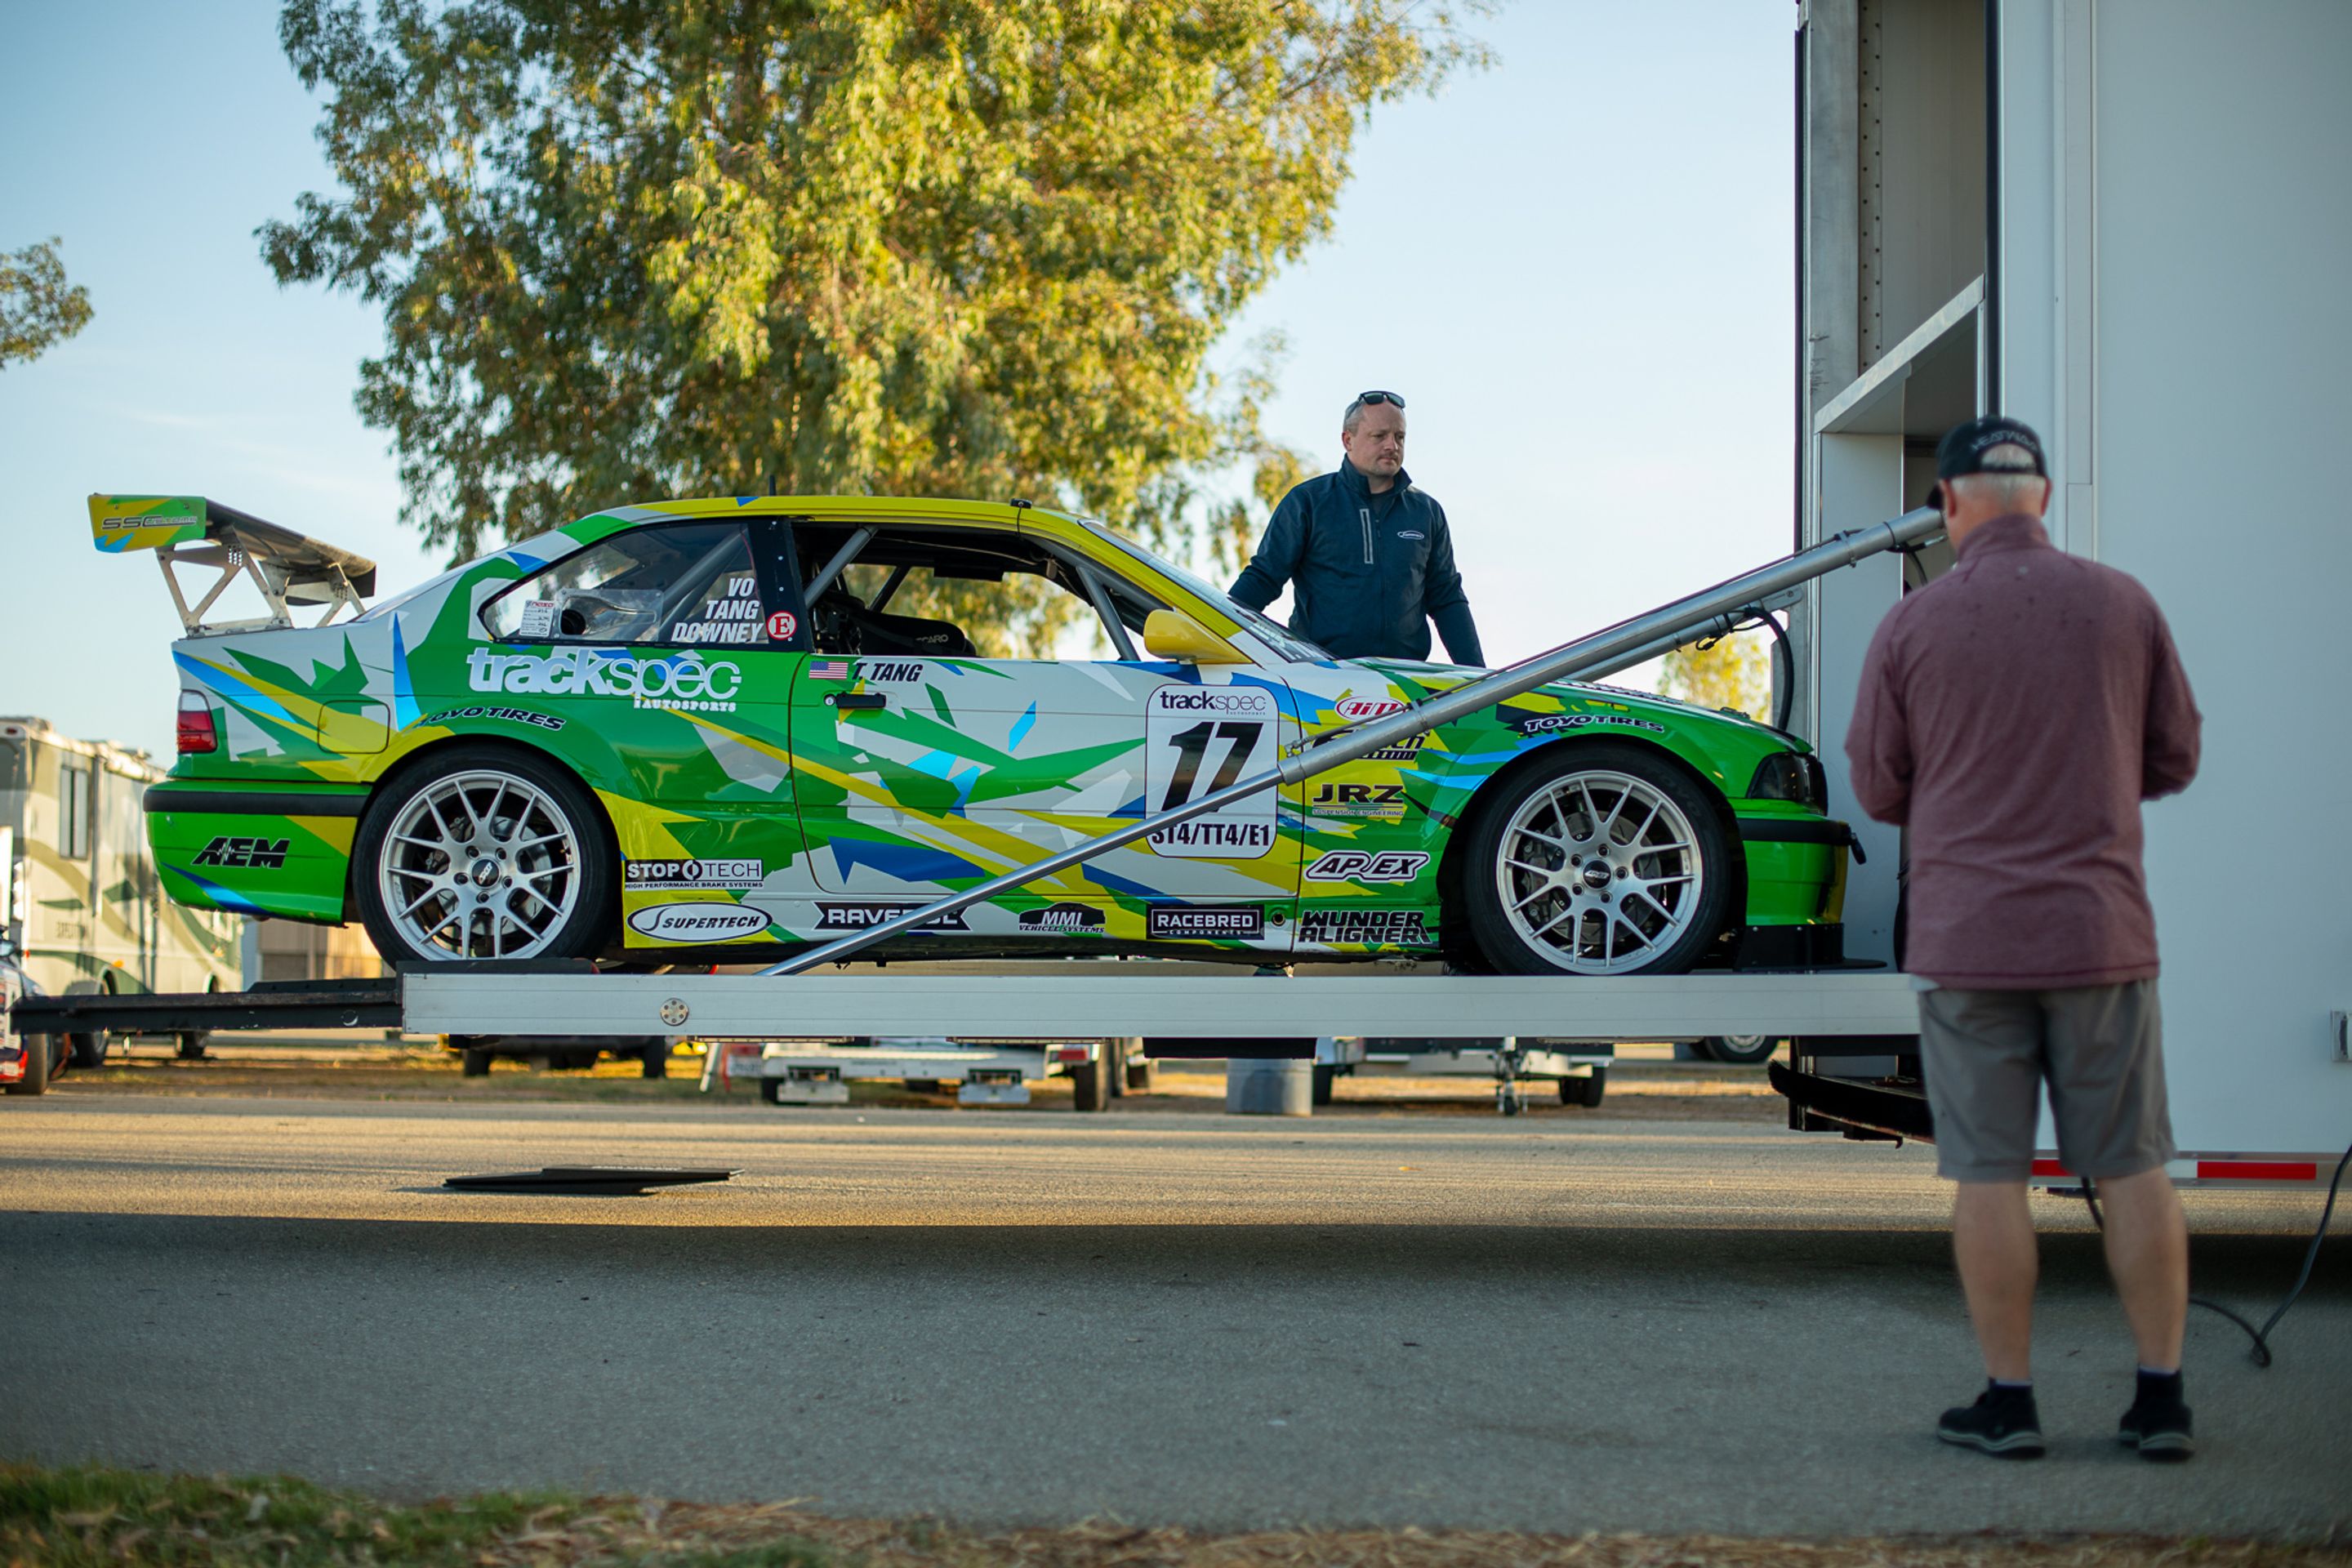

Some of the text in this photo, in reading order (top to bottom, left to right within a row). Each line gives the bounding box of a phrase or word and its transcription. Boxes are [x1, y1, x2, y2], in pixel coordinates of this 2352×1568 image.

[727, 577, 755, 597] VO
[705, 600, 760, 620] TANG
[670, 622, 764, 643] DOWNEY
[467, 647, 742, 708] trackspec
[851, 662, 924, 682] T. TANG
[642, 698, 737, 712] AUTOSPORTS
[1160, 690, 1266, 715] trackspec
[487, 706, 567, 731] TIRES
[1525, 715, 1665, 733] TOYO TIRES
[1161, 721, 1263, 813] 17
[1312, 783, 1404, 804] JRZ
[1152, 822, 1269, 846] ST4/TT4/E1
[190, 835, 291, 869] AEM
[1312, 856, 1423, 875] APEX
[662, 915, 760, 929] SUPERTECH
[827, 908, 958, 924] RAVEL
[1041, 911, 1083, 926] MMI
[1157, 915, 1254, 927] RACEBRED
[1301, 910, 1426, 927] WUNDER
[1298, 927, 1429, 944] ALIGNER
